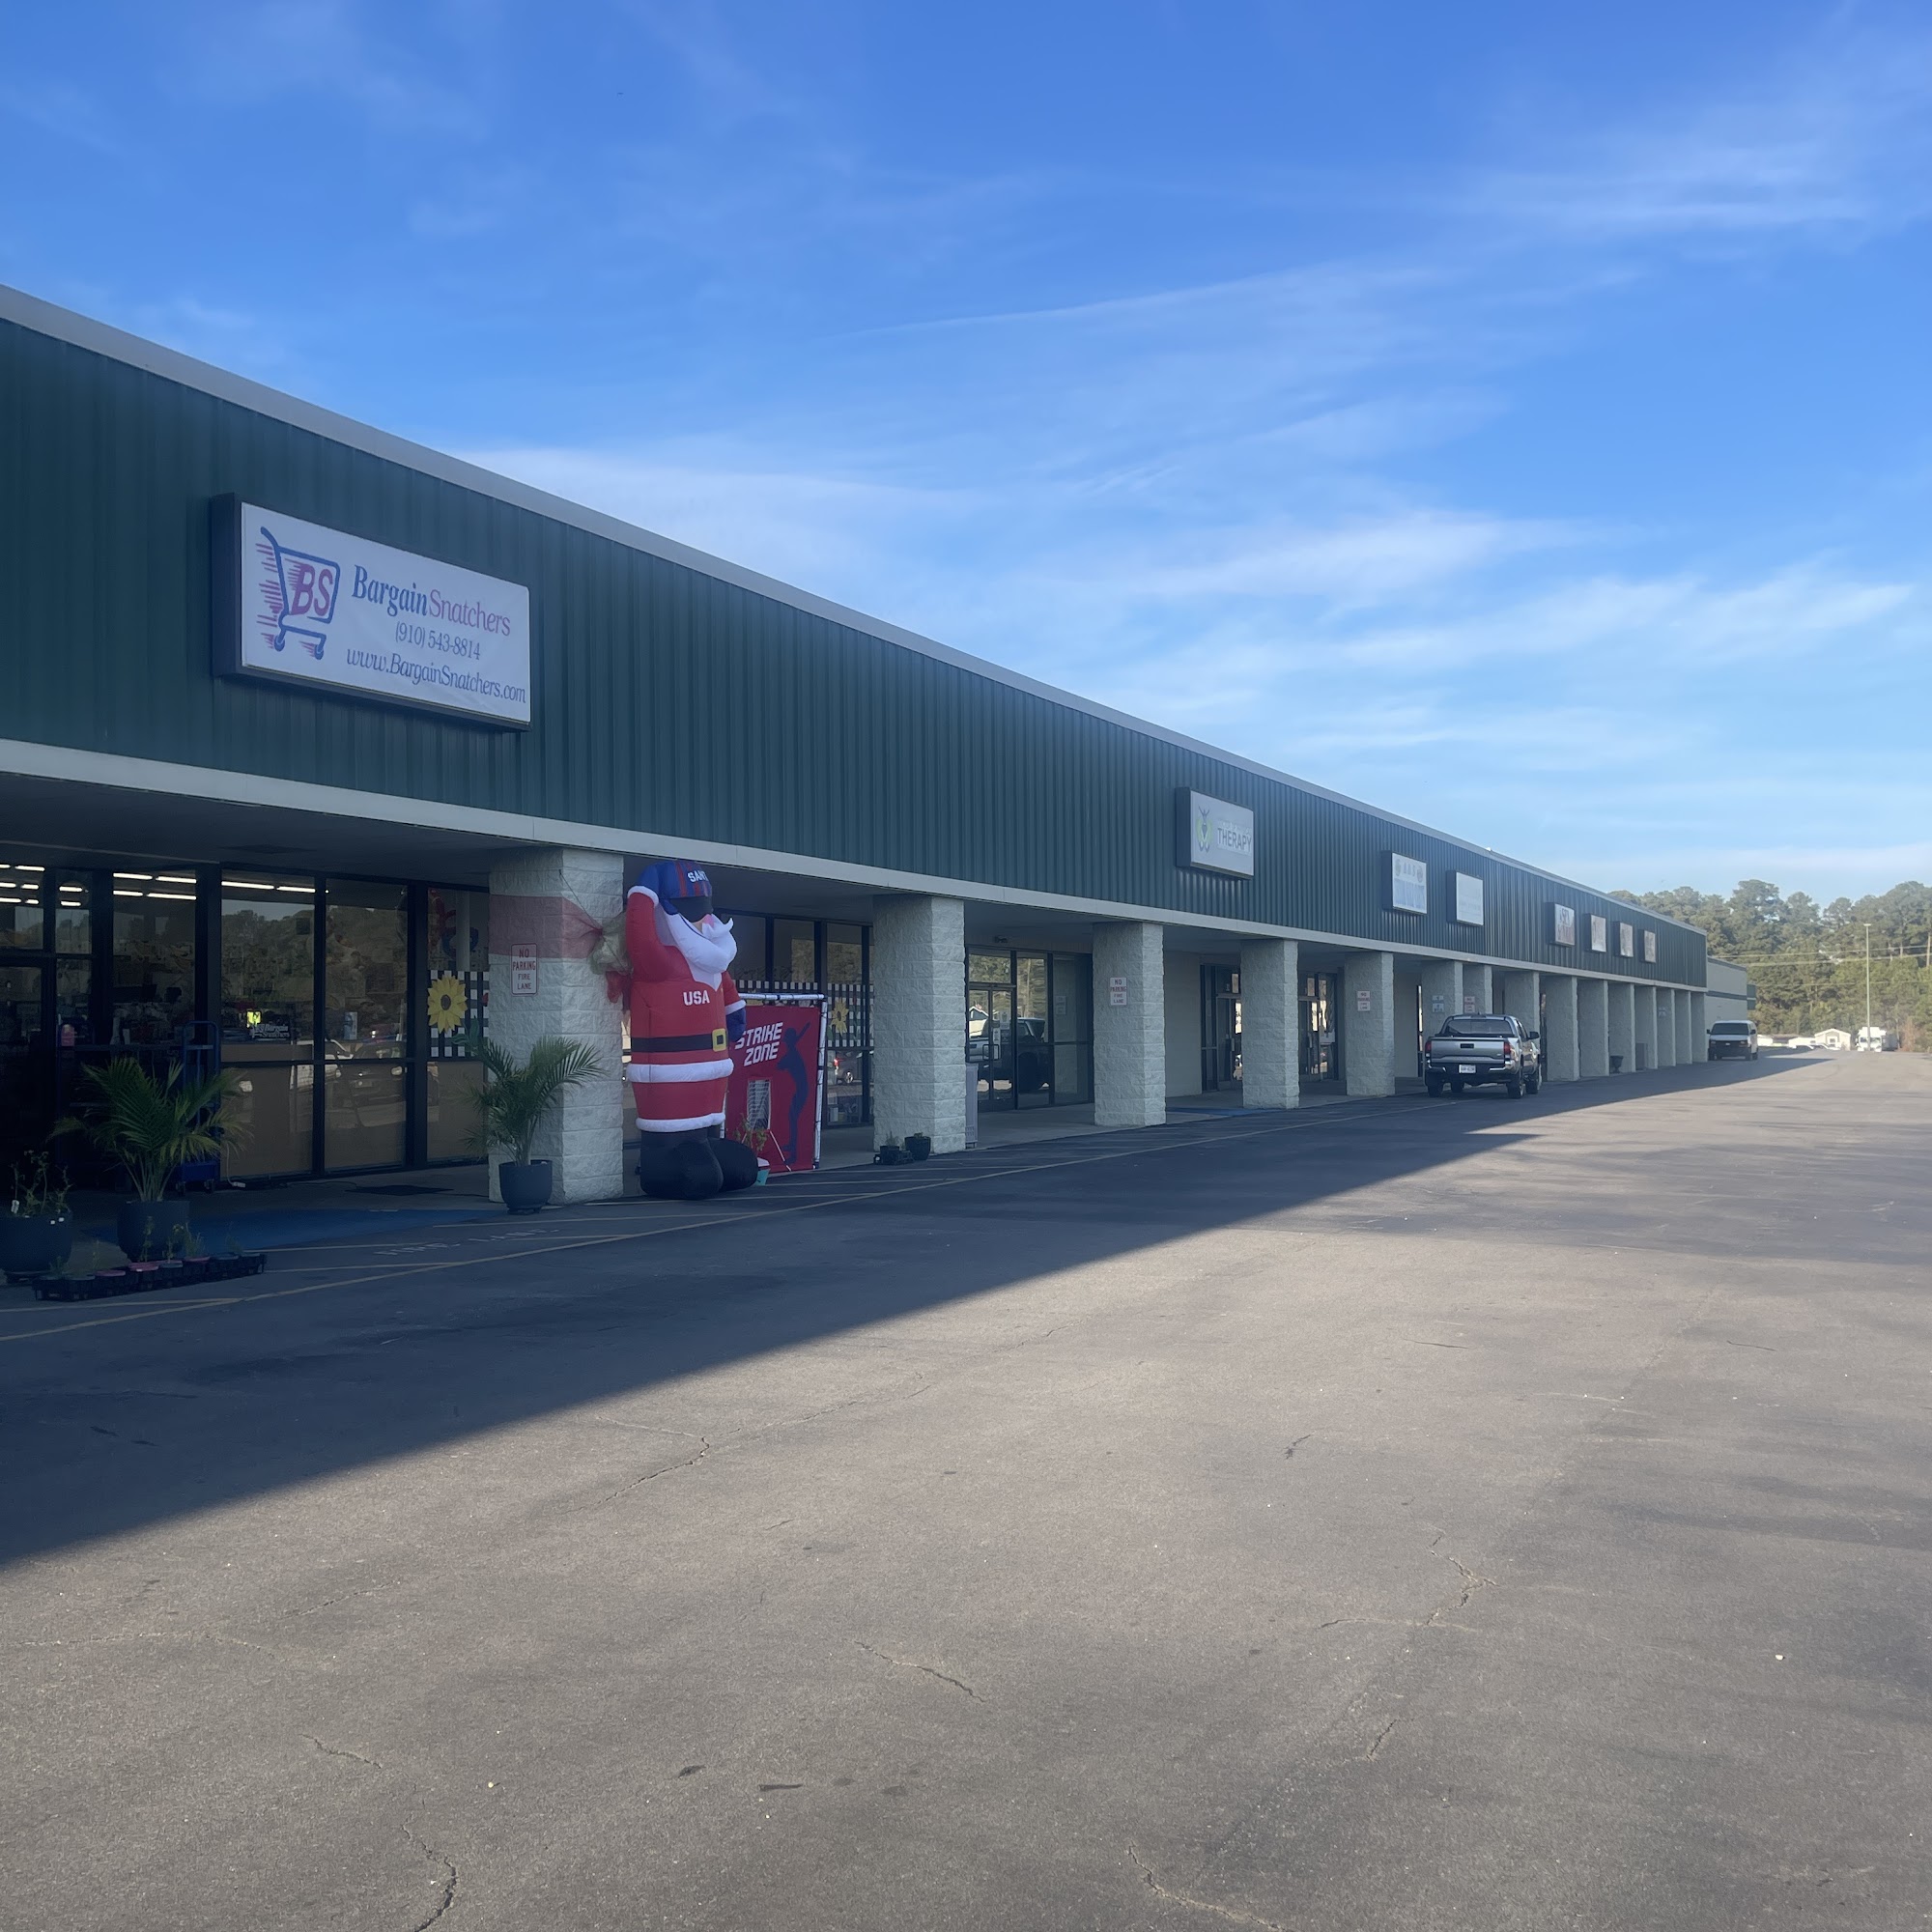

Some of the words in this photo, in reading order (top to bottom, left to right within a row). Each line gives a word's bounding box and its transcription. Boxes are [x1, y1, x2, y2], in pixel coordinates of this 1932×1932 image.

[290, 562, 334, 618] BS
[395, 620, 426, 649] (910)
[428, 630, 481, 661] 543-8814
[347, 648, 526, 704] www.BargainSnatchers.com
[1217, 827, 1252, 853] THERAPY
[512, 960, 536, 972] PARKING
[519, 948, 530, 958] NO
[683, 990, 710, 1006] USA
[734, 1022, 783, 1050] STRIKE
[743, 1041, 781, 1067] ZONE
